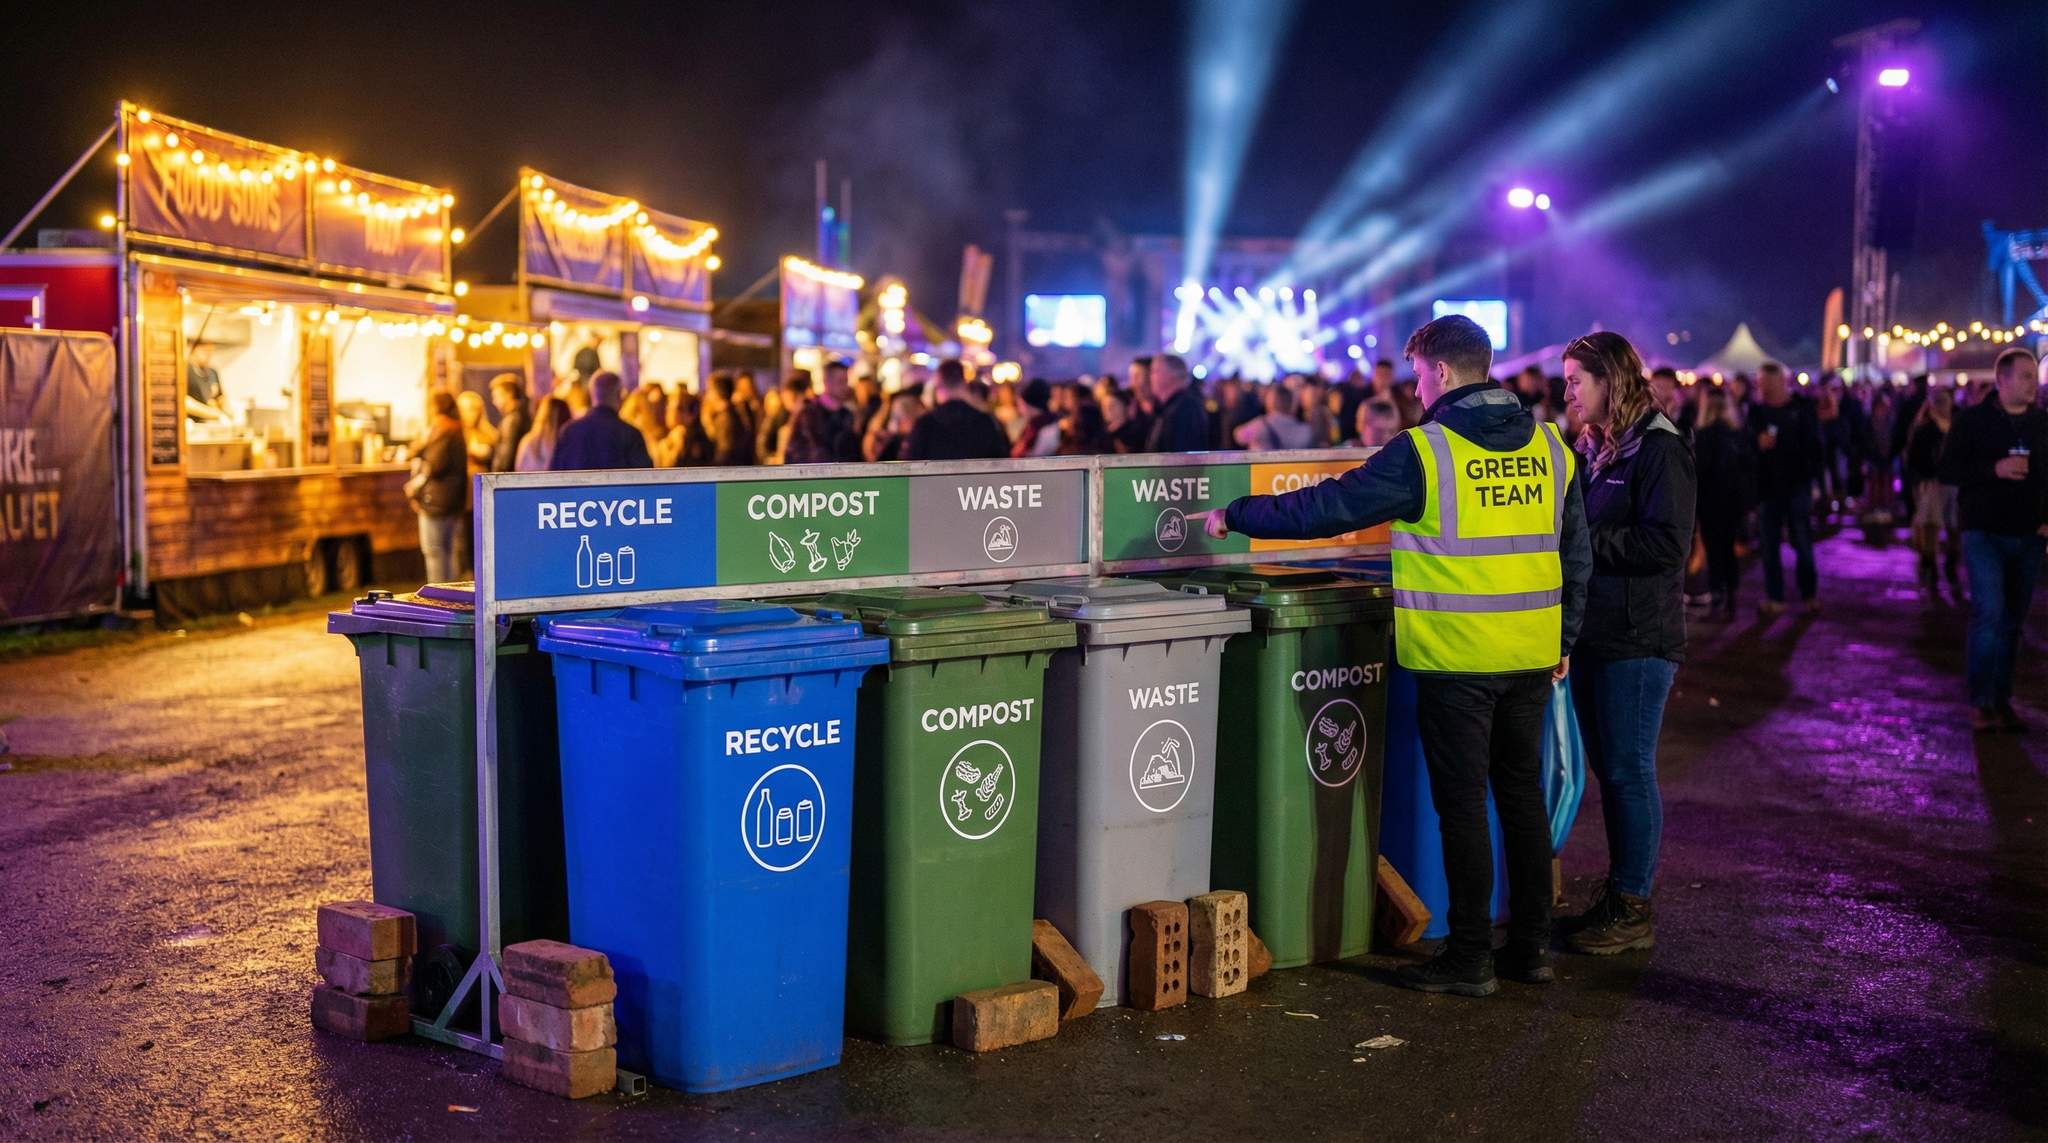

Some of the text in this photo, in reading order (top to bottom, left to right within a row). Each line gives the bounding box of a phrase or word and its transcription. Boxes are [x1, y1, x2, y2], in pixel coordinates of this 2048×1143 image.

[0, 428, 61, 484] KE...
[1466, 456, 1547, 480] GREEN
[958, 484, 1042, 511] WASTE
[1132, 478, 1209, 502] WASTE
[1272, 472, 1343, 496] COM
[1475, 484, 1543, 507] TEAM
[538, 498, 673, 530] RECYCLE
[747, 490, 880, 521] COMPOST
[1290, 662, 1383, 692] COMPOST
[1128, 682, 1199, 710] WASTE
[921, 698, 1034, 733] COMPOST
[725, 719, 841, 756] RECYCLE
